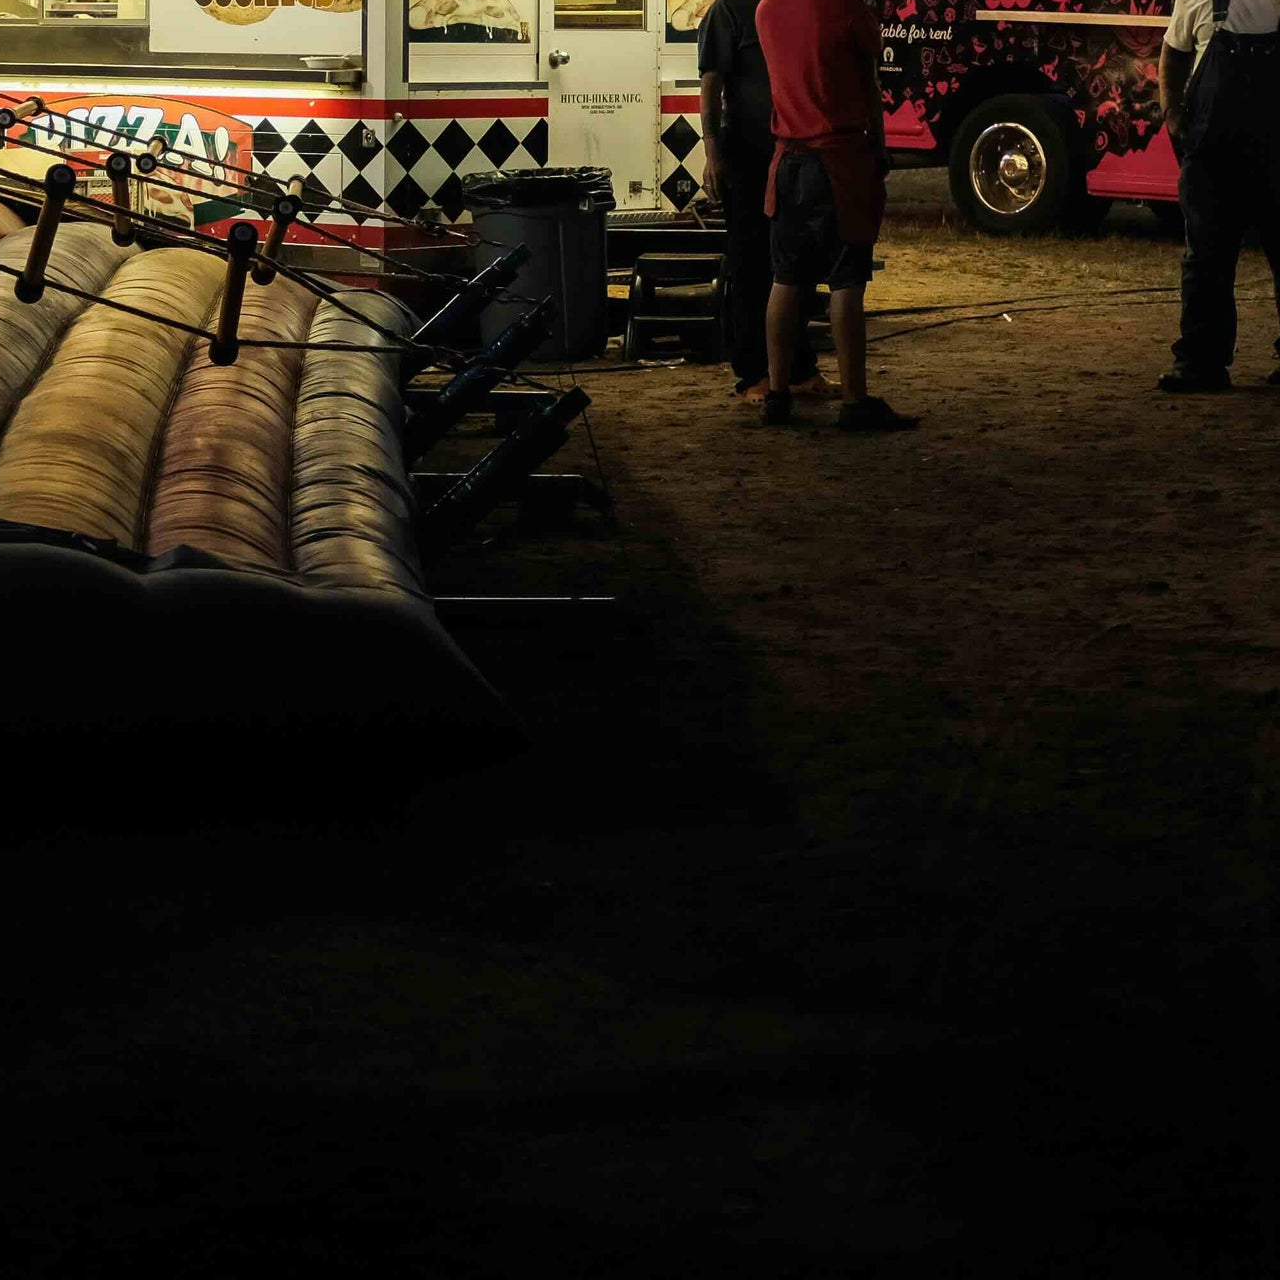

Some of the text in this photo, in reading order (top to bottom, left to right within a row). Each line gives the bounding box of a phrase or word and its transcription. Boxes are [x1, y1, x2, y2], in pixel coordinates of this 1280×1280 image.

[907, 24, 928, 44] for
[929, 25, 953, 40] rent
[561, 94, 643, 104] HITCH-HIKER MFG.
